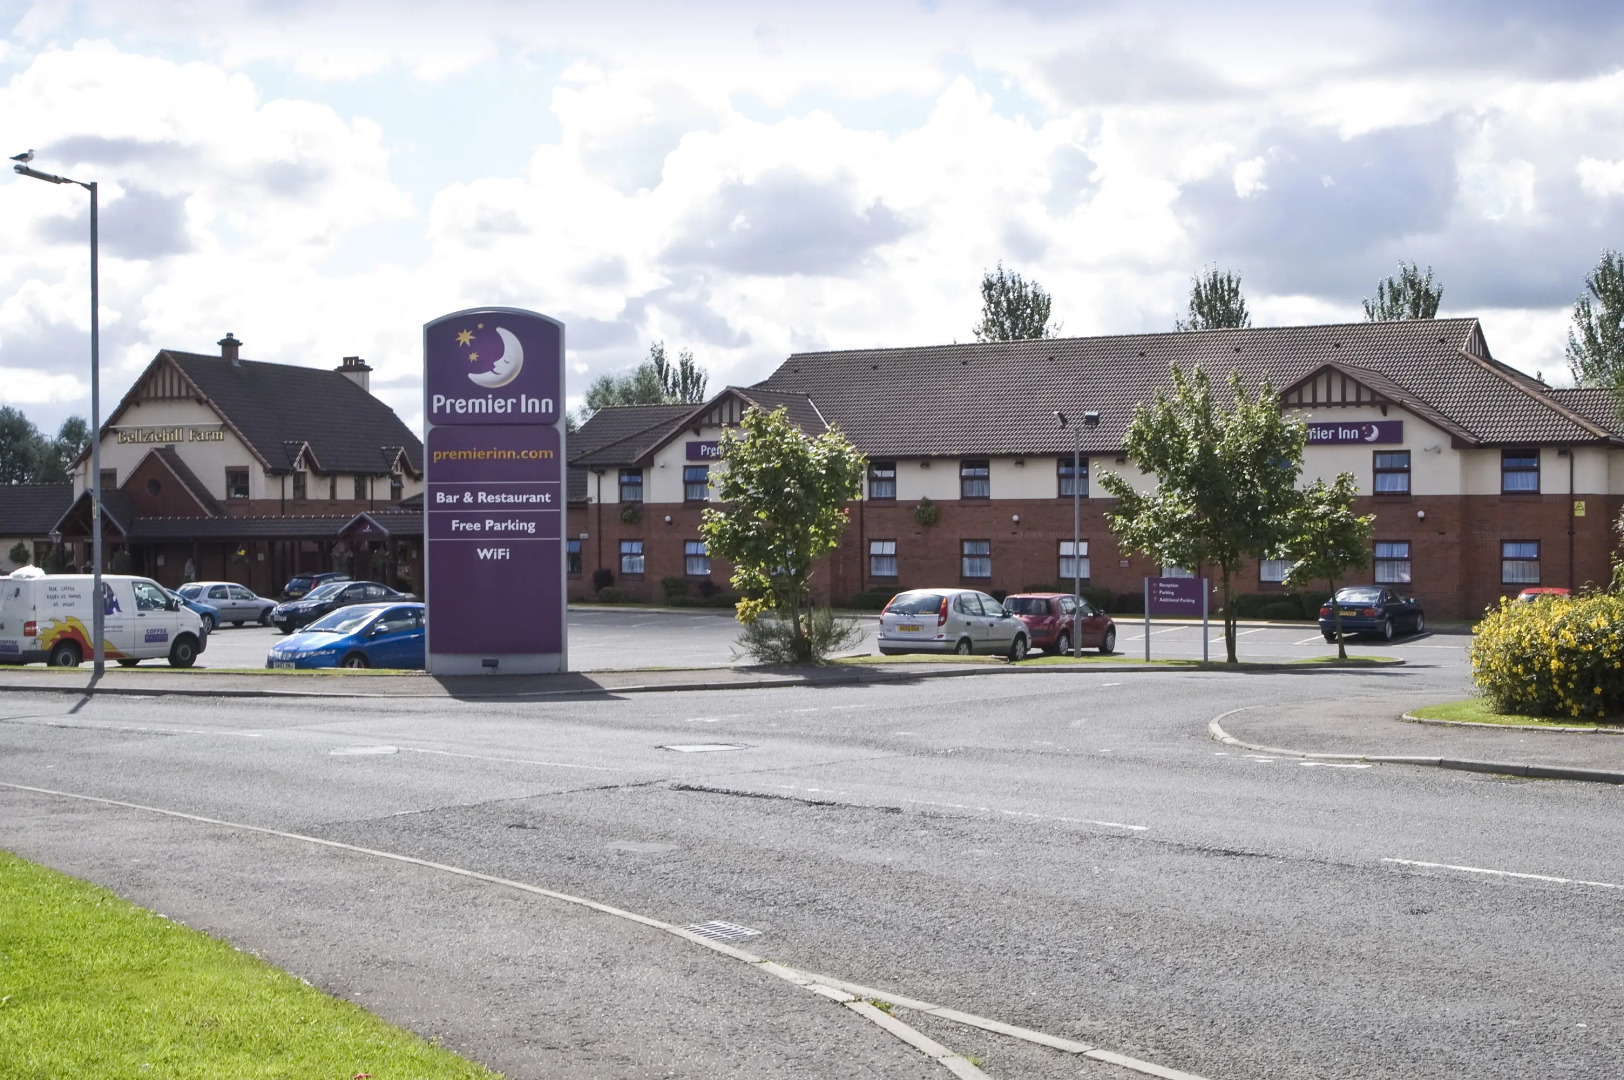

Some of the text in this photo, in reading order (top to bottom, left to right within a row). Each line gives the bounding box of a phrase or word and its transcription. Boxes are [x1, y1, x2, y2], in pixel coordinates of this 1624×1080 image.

[432, 394, 553, 414] Premier Inn
[188, 428, 225, 442] Farm
[1306, 426, 1359, 439] mier Inn
[433, 447, 554, 464] premierinn.com
[436, 491, 551, 503] Bar & Restaurant
[451, 519, 536, 534] Free Parking
[476, 548, 510, 560] WiFi
